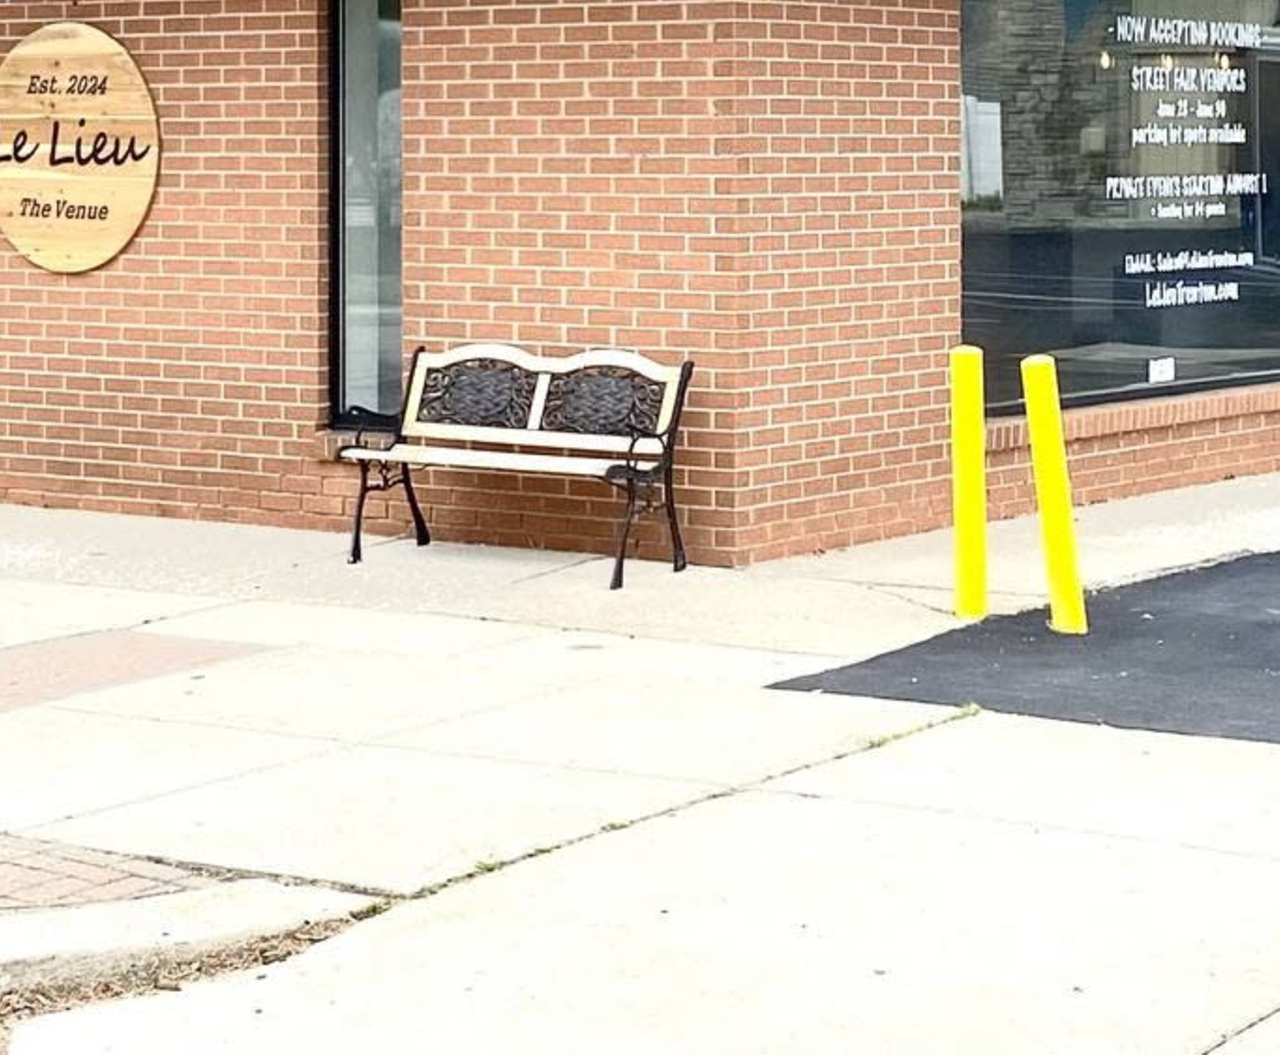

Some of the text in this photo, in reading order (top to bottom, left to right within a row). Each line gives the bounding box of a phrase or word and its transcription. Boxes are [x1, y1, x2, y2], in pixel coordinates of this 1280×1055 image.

[1117, 16, 1147, 42] NOW
[1149, 18, 1208, 45] ACCEPTING
[1210, 21, 1261, 47] BOOKINGS
[27, 75, 108, 96] Est. 2024
[1131, 66, 1246, 92] STREET FAIR VENDORS
[49, 118, 151, 166] Lieu
[1132, 122, 1167, 148] parking
[1169, 123, 1182, 144] lot
[1106, 176, 1146, 199] PRIVATE
[1146, 175, 1180, 197] EVENTS
[1182, 174, 1225, 195] STARTING
[1226, 173, 1260, 195] AUGUST
[19, 198, 108, 220] The Venue
